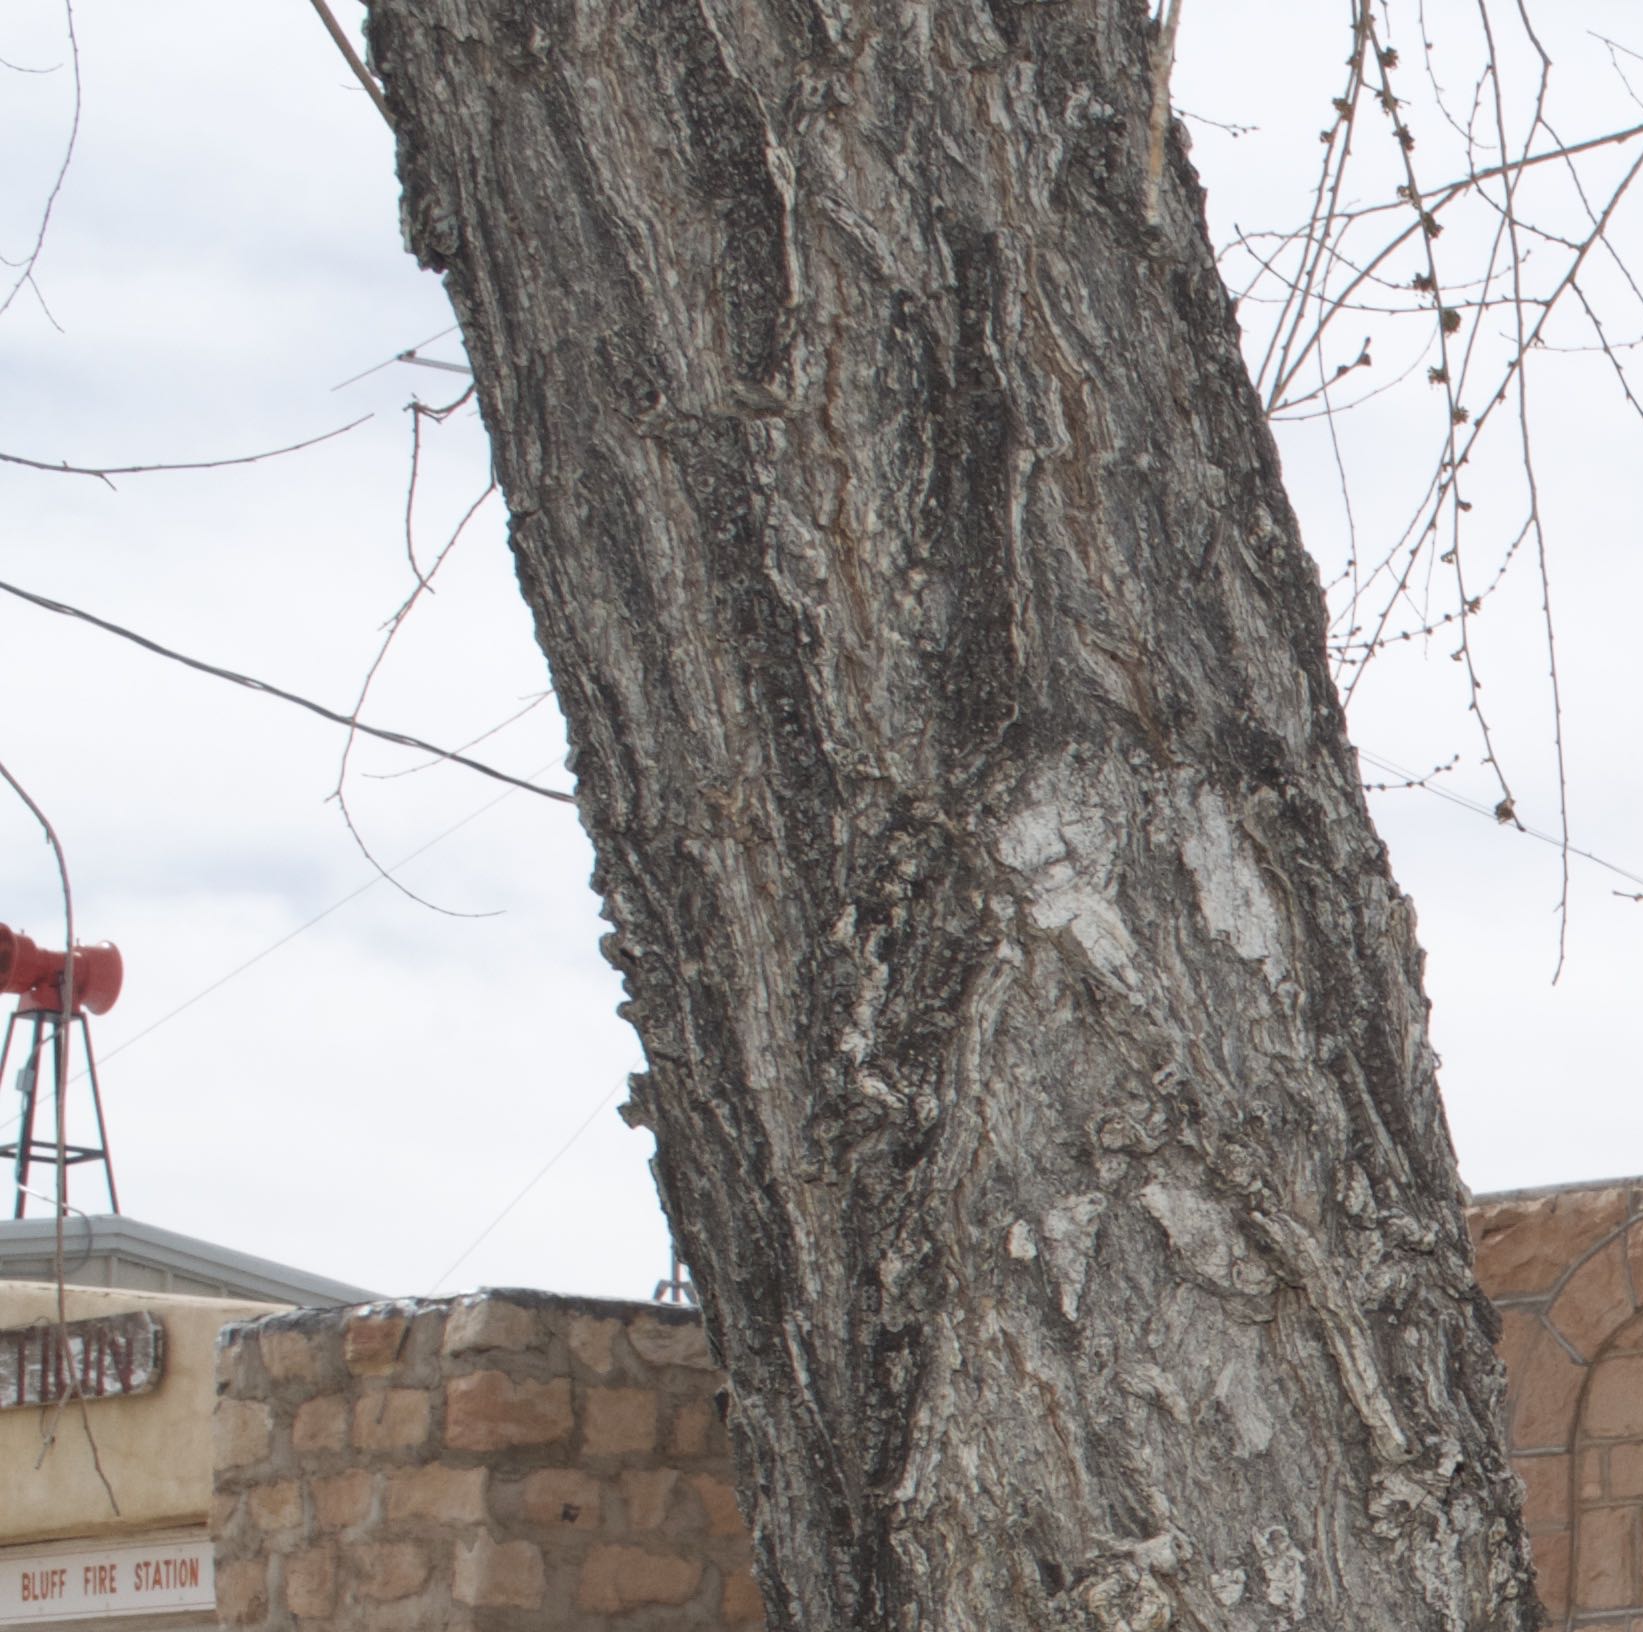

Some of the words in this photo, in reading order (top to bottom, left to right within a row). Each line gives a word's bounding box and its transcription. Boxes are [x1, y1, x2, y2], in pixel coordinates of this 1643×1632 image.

[21, 1569, 67, 1601] BLUFF
[83, 1563, 118, 1595] FIRE
[133, 1557, 200, 1592] STATION
